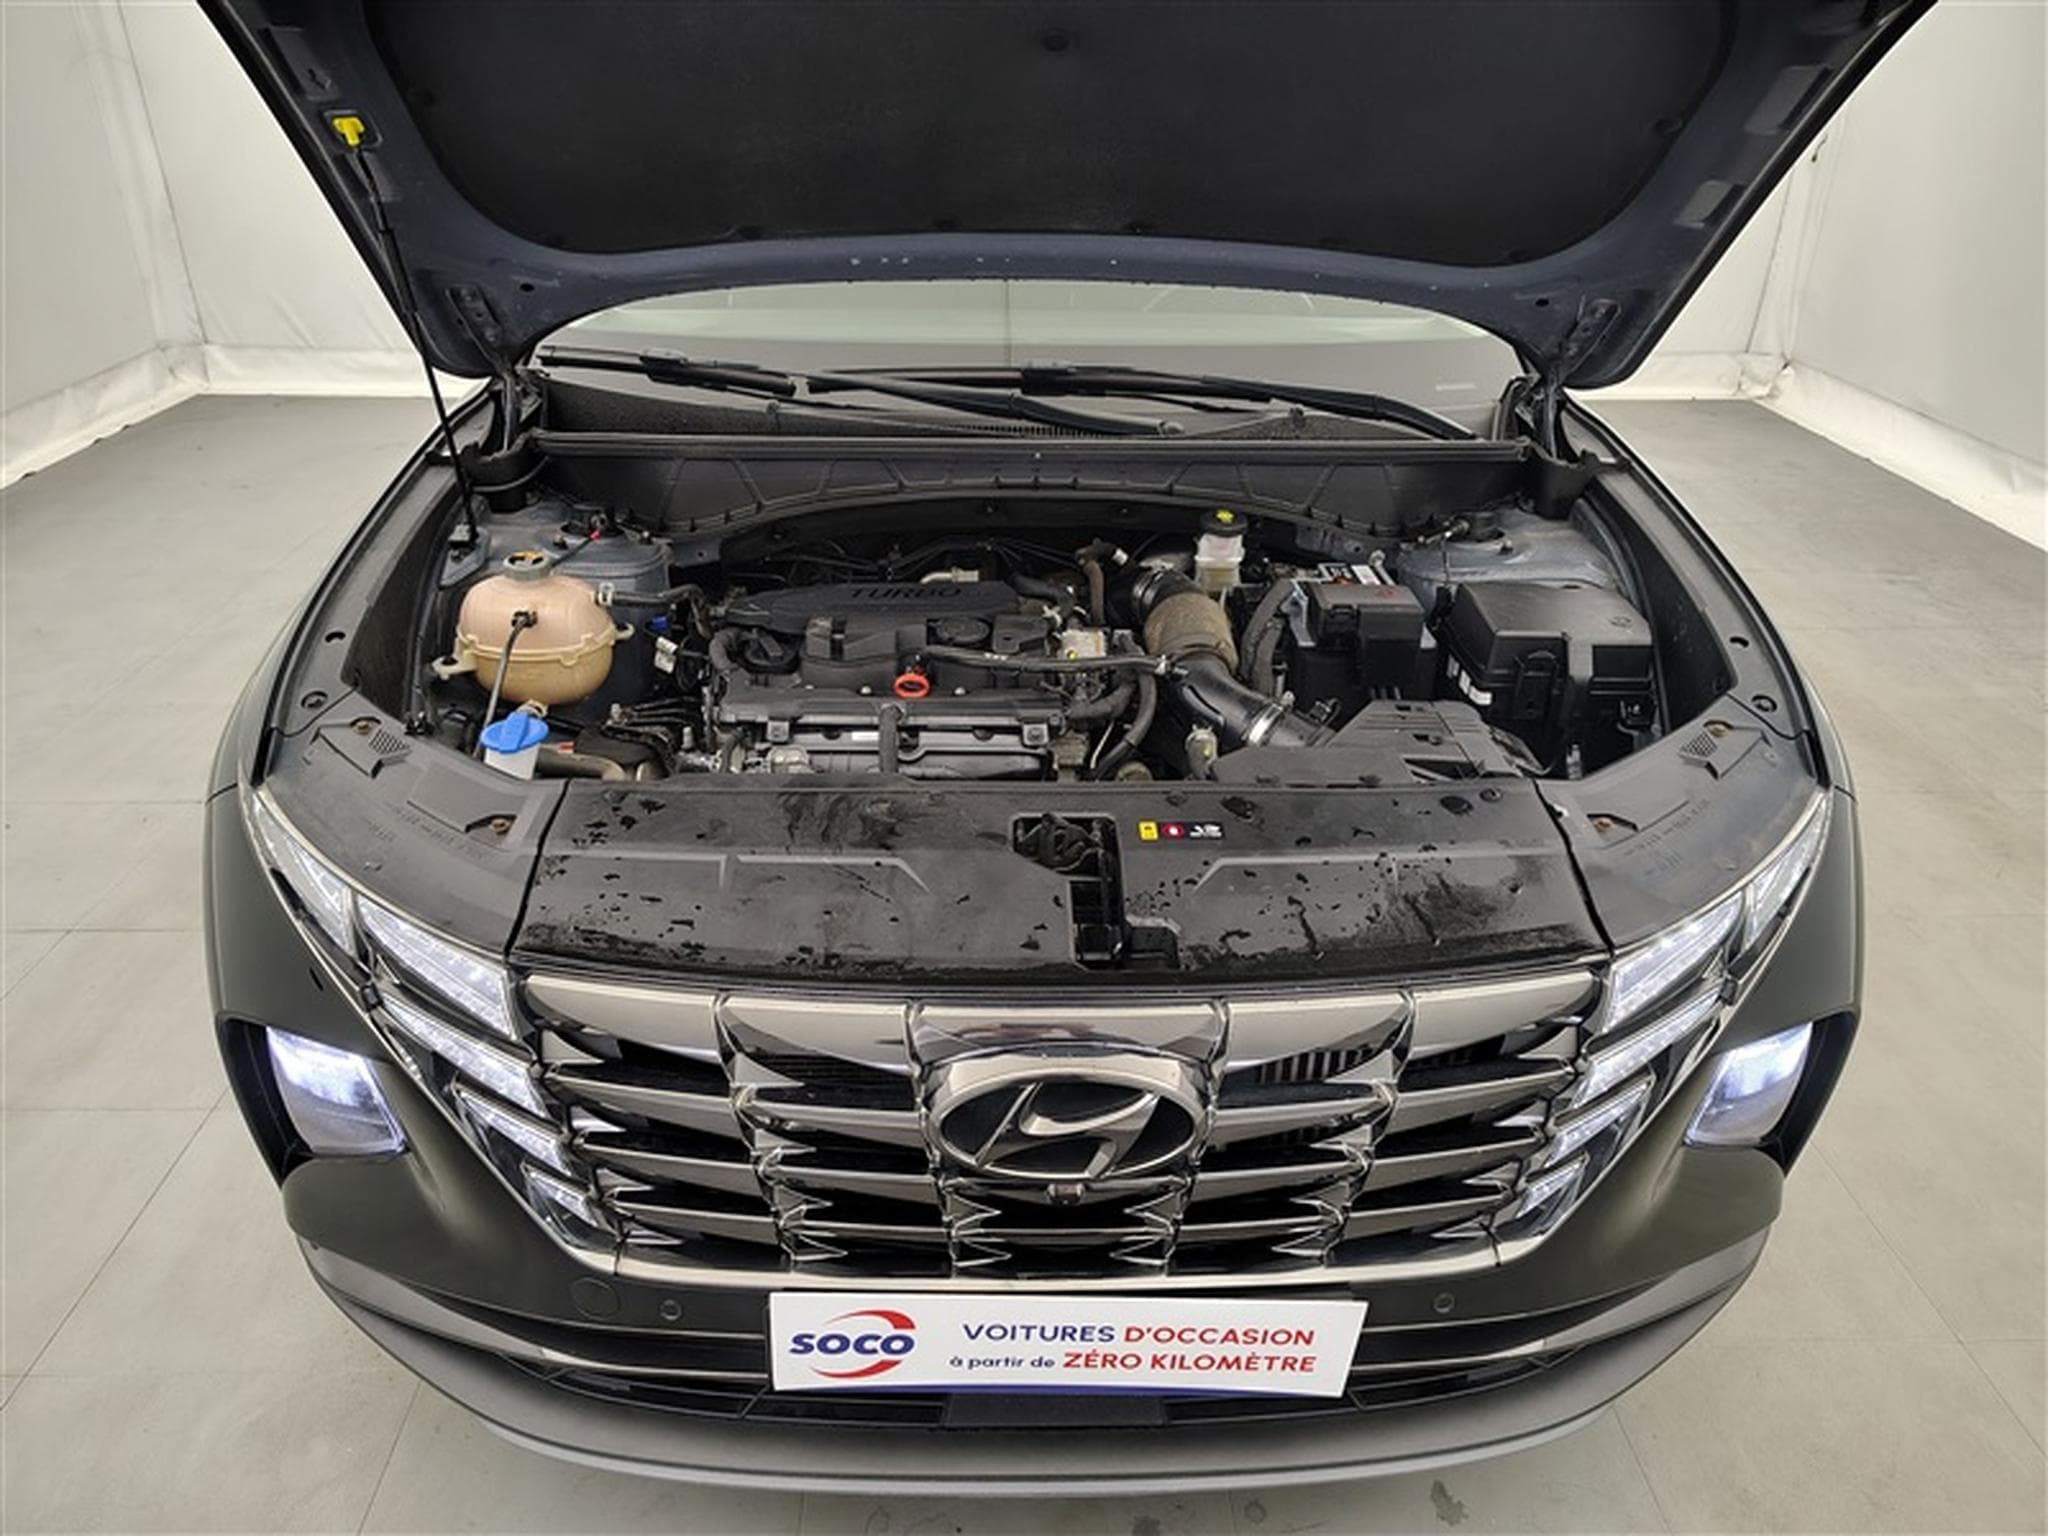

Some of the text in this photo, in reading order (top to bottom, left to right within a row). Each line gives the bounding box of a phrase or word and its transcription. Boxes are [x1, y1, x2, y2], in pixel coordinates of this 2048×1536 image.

[851, 587, 962, 599] TURBO
[789, 1333, 915, 1355] SOCO
[963, 1324, 1314, 1345] VOITURES D'OCCASION
[949, 1349, 1316, 1372] à partir de ZÉRO KILOMÈTRE
